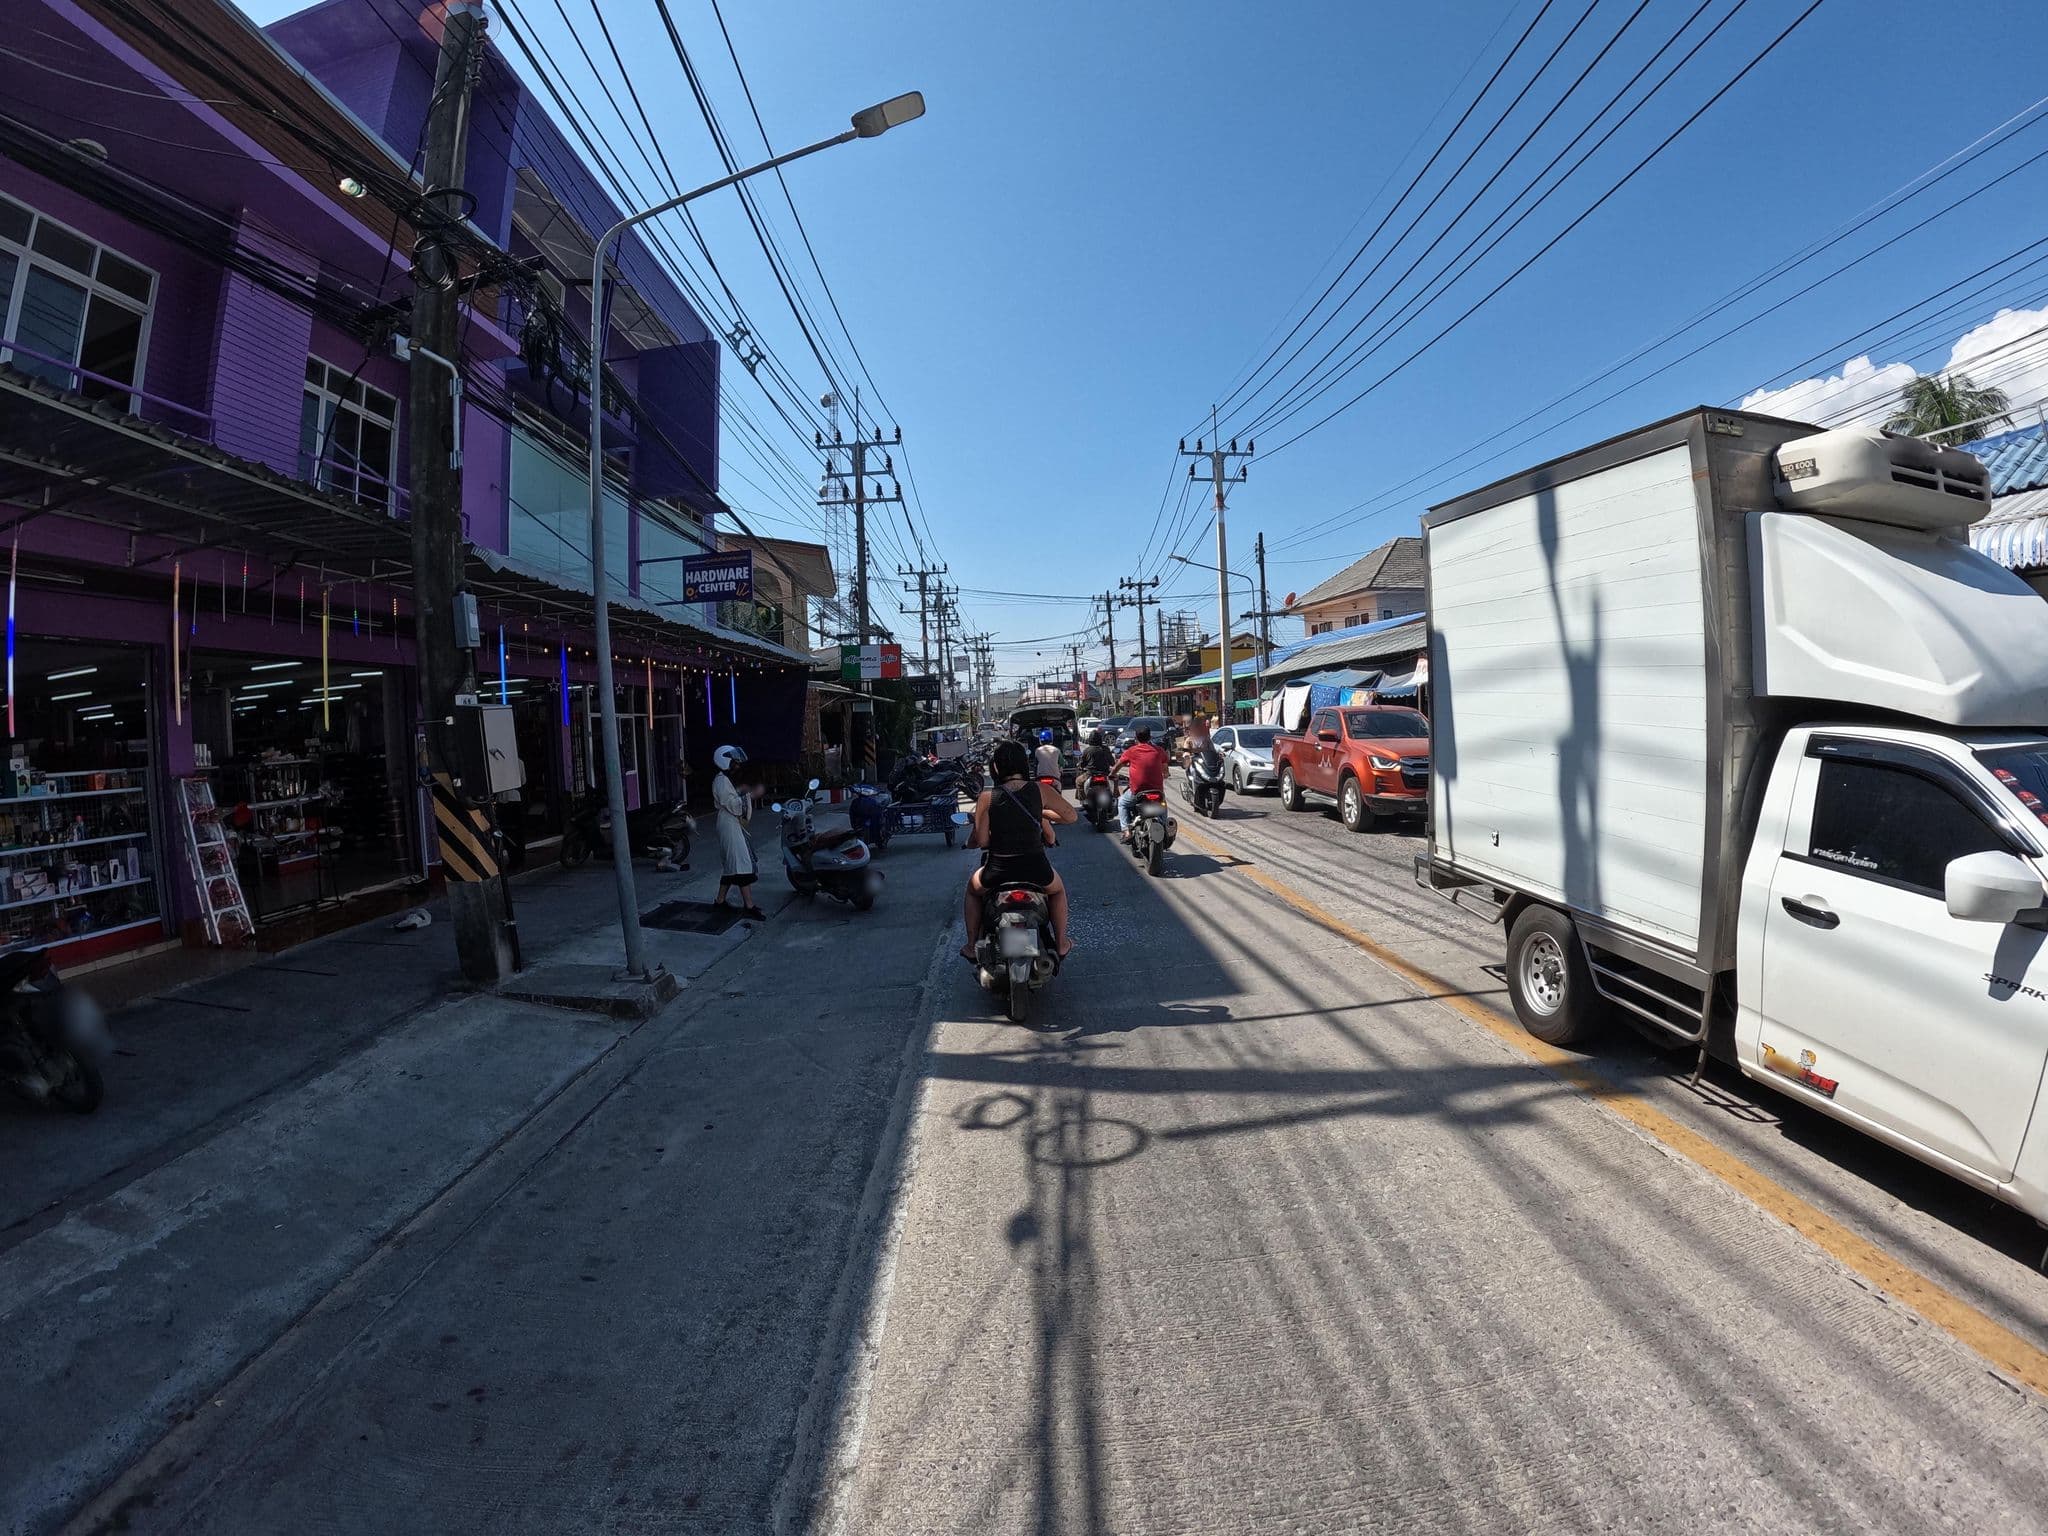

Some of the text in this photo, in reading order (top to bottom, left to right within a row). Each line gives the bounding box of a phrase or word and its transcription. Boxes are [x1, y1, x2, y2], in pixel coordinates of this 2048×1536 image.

[685, 566, 749, 584] HARDWARE
[698, 581, 736, 593] CENTER
[844, 654, 878, 664] Mamma
[1981, 973, 2048, 1001] SPARK
